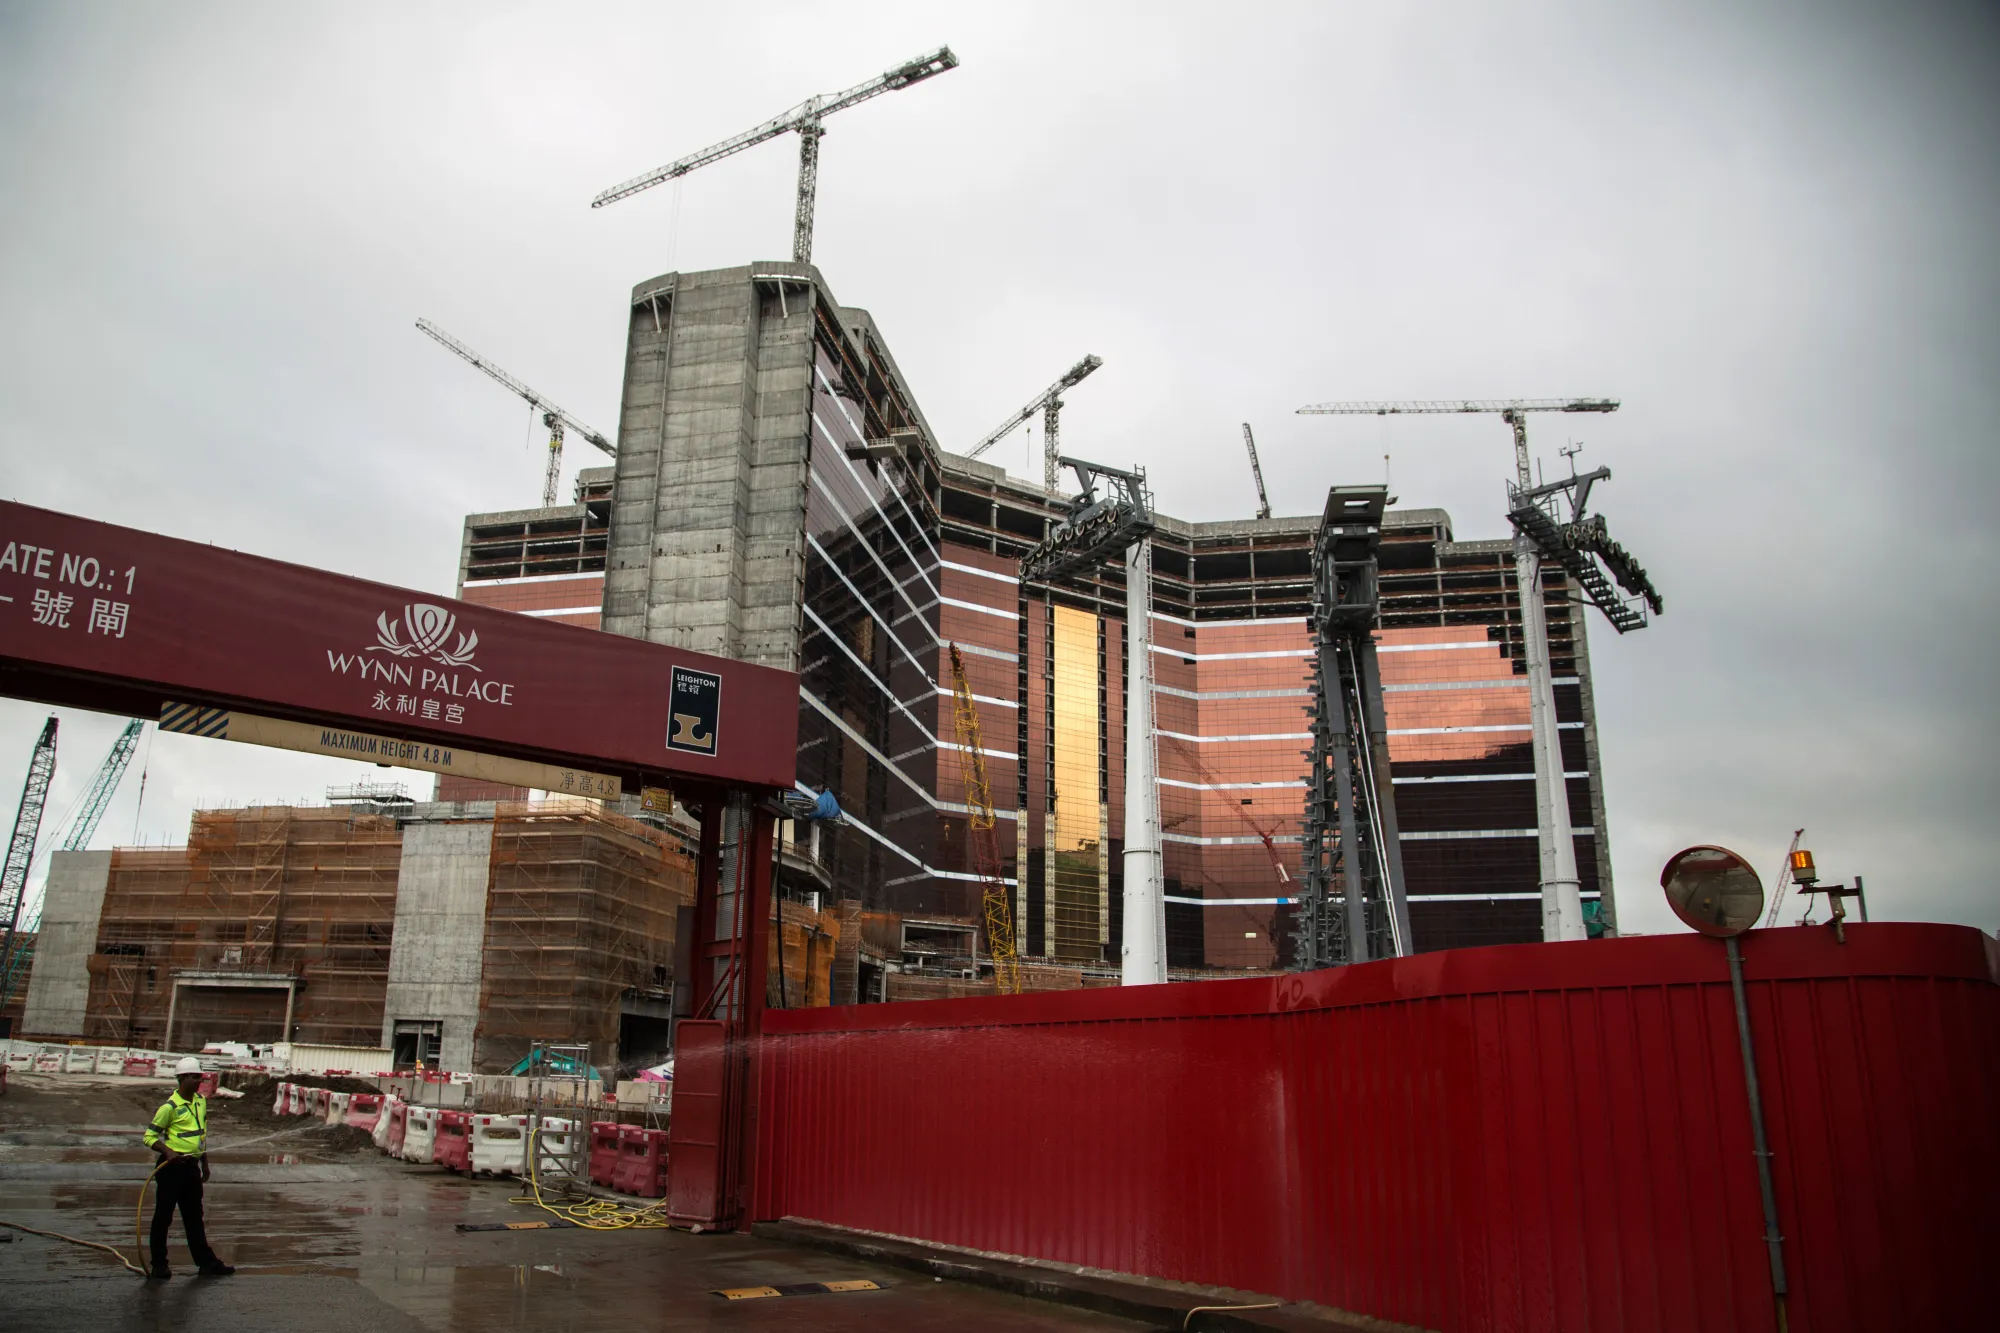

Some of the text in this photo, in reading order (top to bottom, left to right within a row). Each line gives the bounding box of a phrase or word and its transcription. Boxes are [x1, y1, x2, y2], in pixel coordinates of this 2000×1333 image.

[59, 552, 115, 592] NO.:
[125, 566, 136, 595] 1
[327, 650, 515, 706] WYNN PALACE
[676, 673, 716, 688] LEIGHTON
[371, 690, 465, 724] 永利皇宮
[320, 730, 452, 766] MAXIMUM HEIGHT 4.8 M
[597, 779, 615, 796] 4.8
